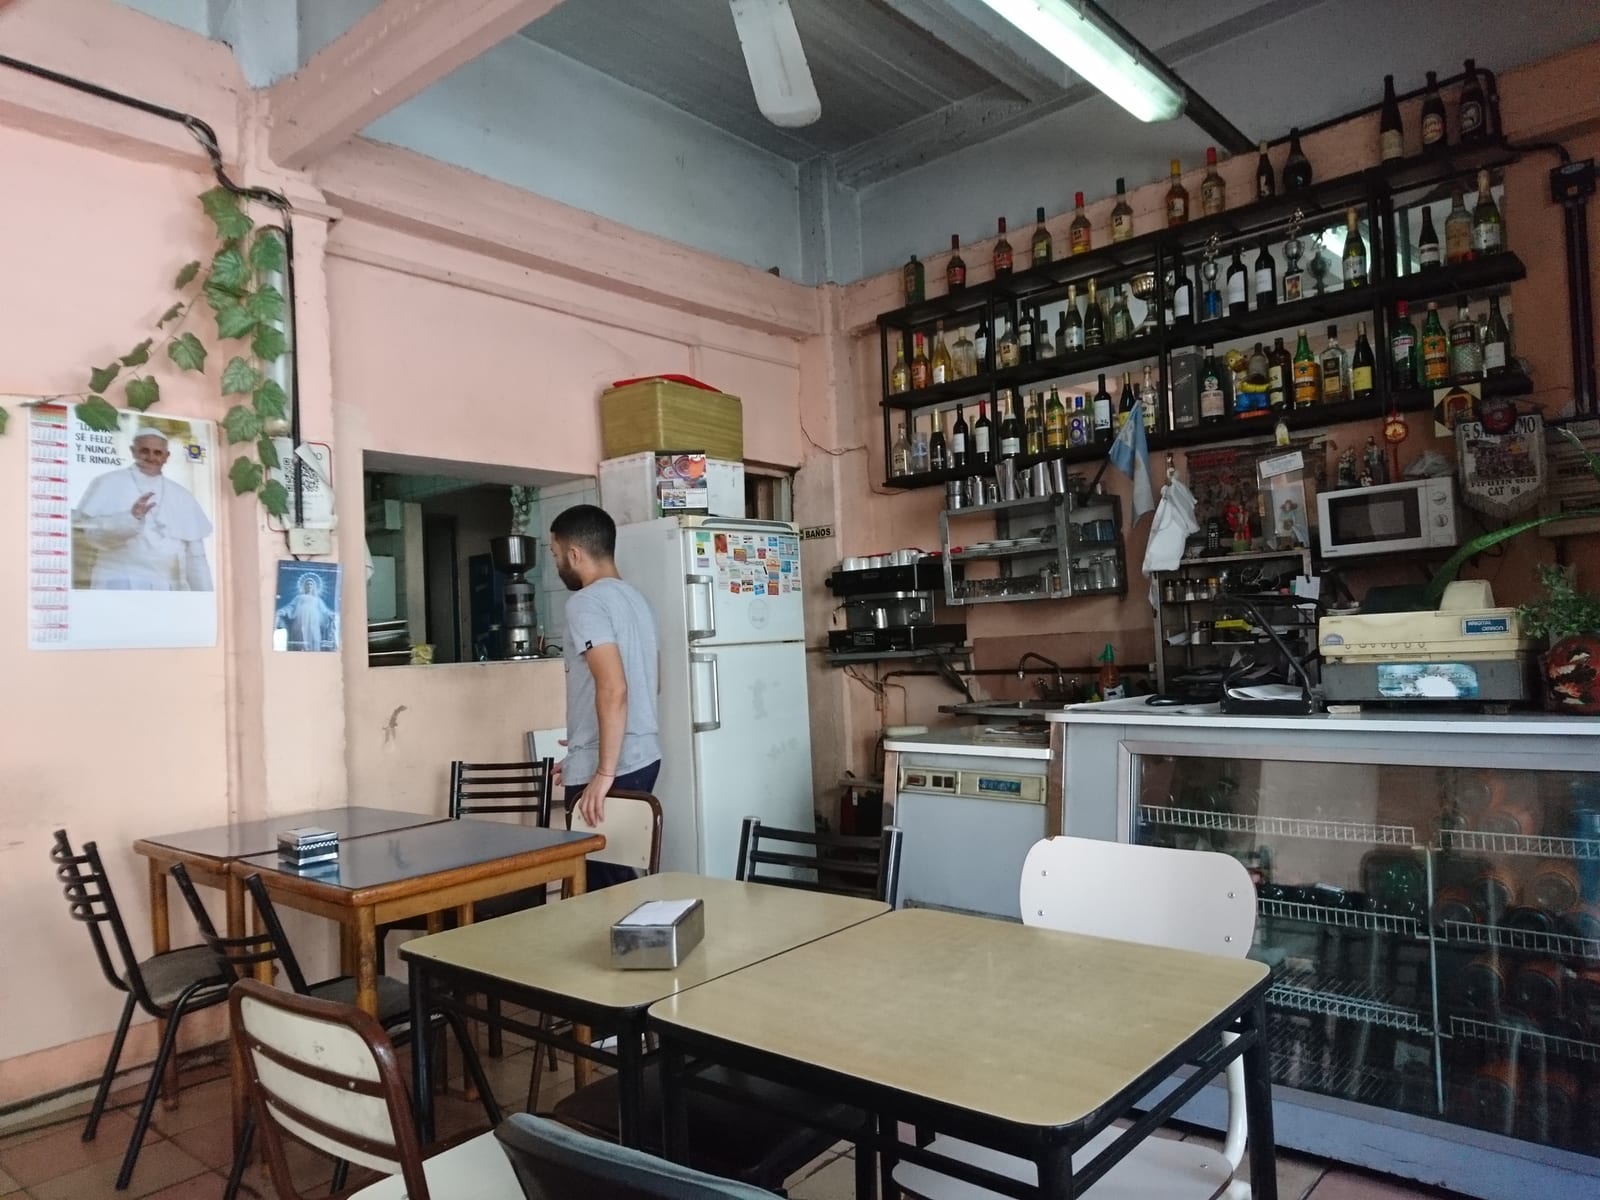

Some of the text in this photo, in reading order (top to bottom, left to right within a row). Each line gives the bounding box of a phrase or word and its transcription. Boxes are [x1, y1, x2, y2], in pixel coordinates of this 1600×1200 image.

[90, 434, 113, 445] FELIZ
[75, 442, 81, 451] Y
[85, 444, 117, 455] NUNCA
[76, 453, 86, 463] TE
[805, 527, 831, 538] BAÑOS
